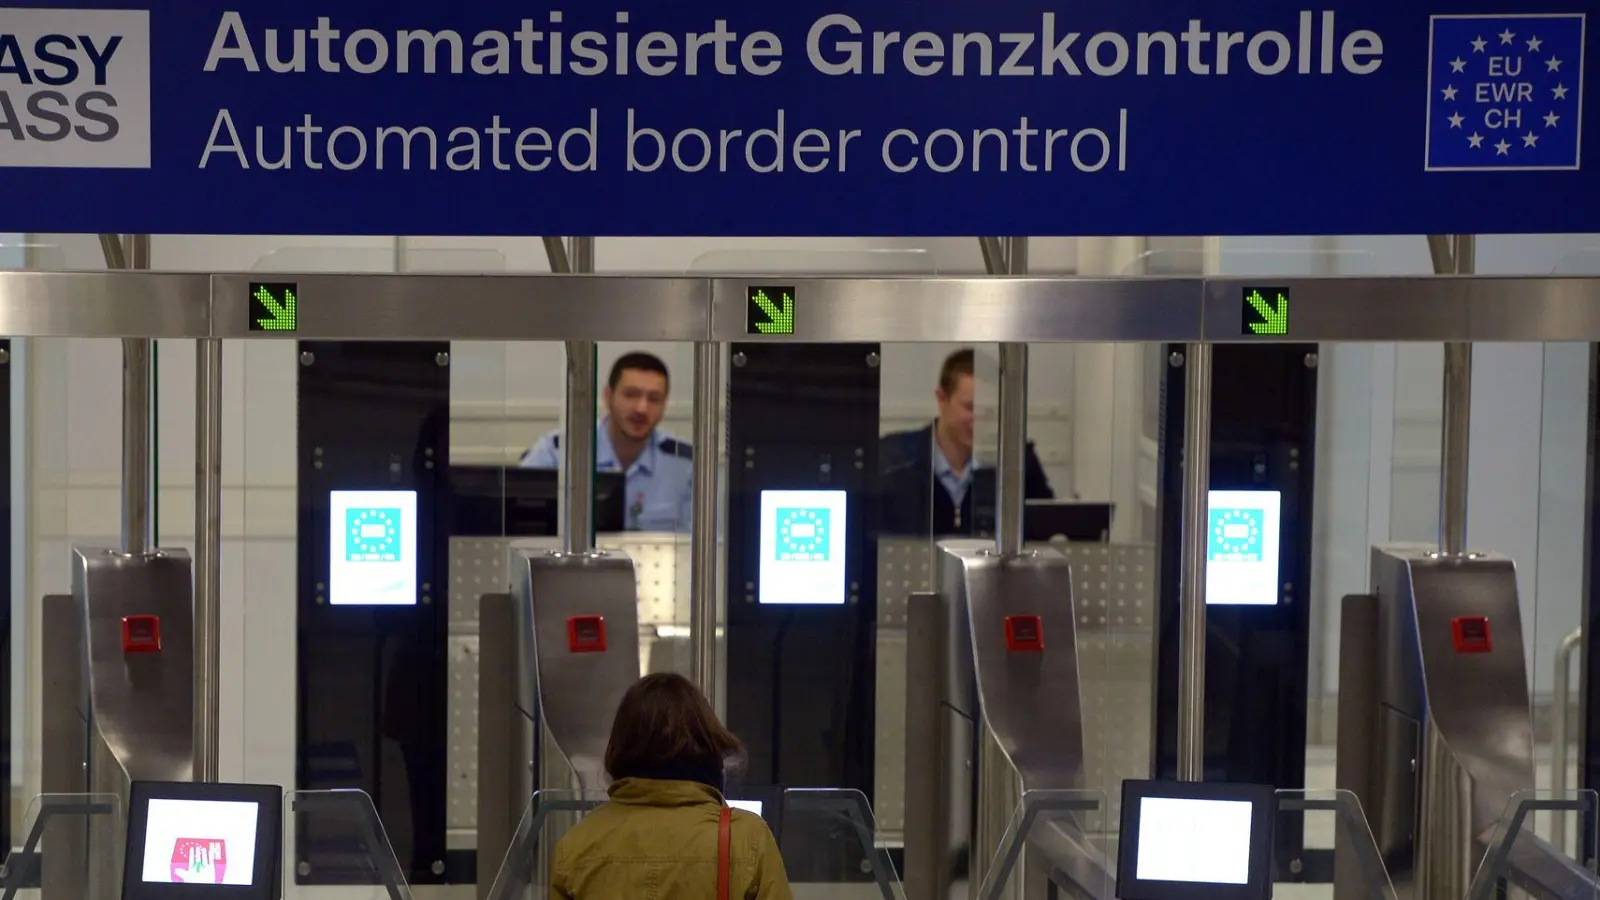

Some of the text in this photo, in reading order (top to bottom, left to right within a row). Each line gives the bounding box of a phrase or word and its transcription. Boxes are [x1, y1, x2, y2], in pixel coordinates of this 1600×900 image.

[203, 10, 1384, 76] Automatisierte Grenzkontrolle
[1488, 56, 1522, 77] EU
[1475, 82, 1533, 103] EWR
[1484, 108, 1521, 129] CH
[198, 107, 1128, 173] Automated border control
